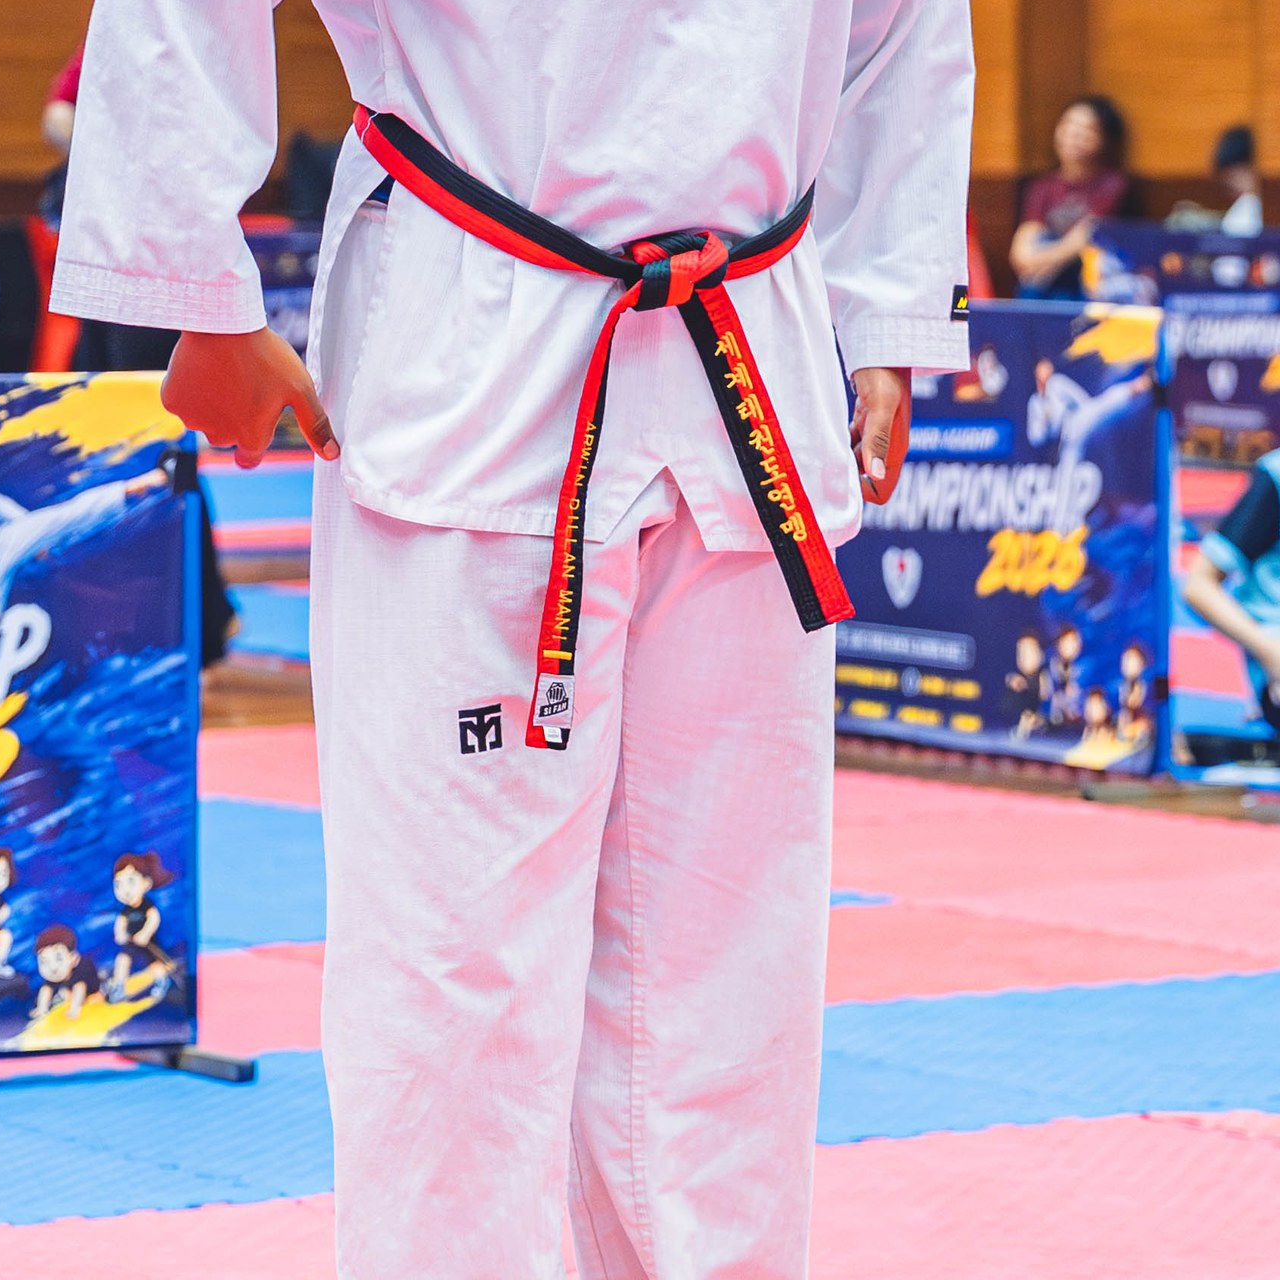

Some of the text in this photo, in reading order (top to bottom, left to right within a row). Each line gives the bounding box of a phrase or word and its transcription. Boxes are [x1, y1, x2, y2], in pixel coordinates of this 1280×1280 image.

[552, 421, 597, 640] ARWIN DILLAN MANI
[975, 523, 1089, 598] 2026
[543, 701, 567, 716] SI FAN
